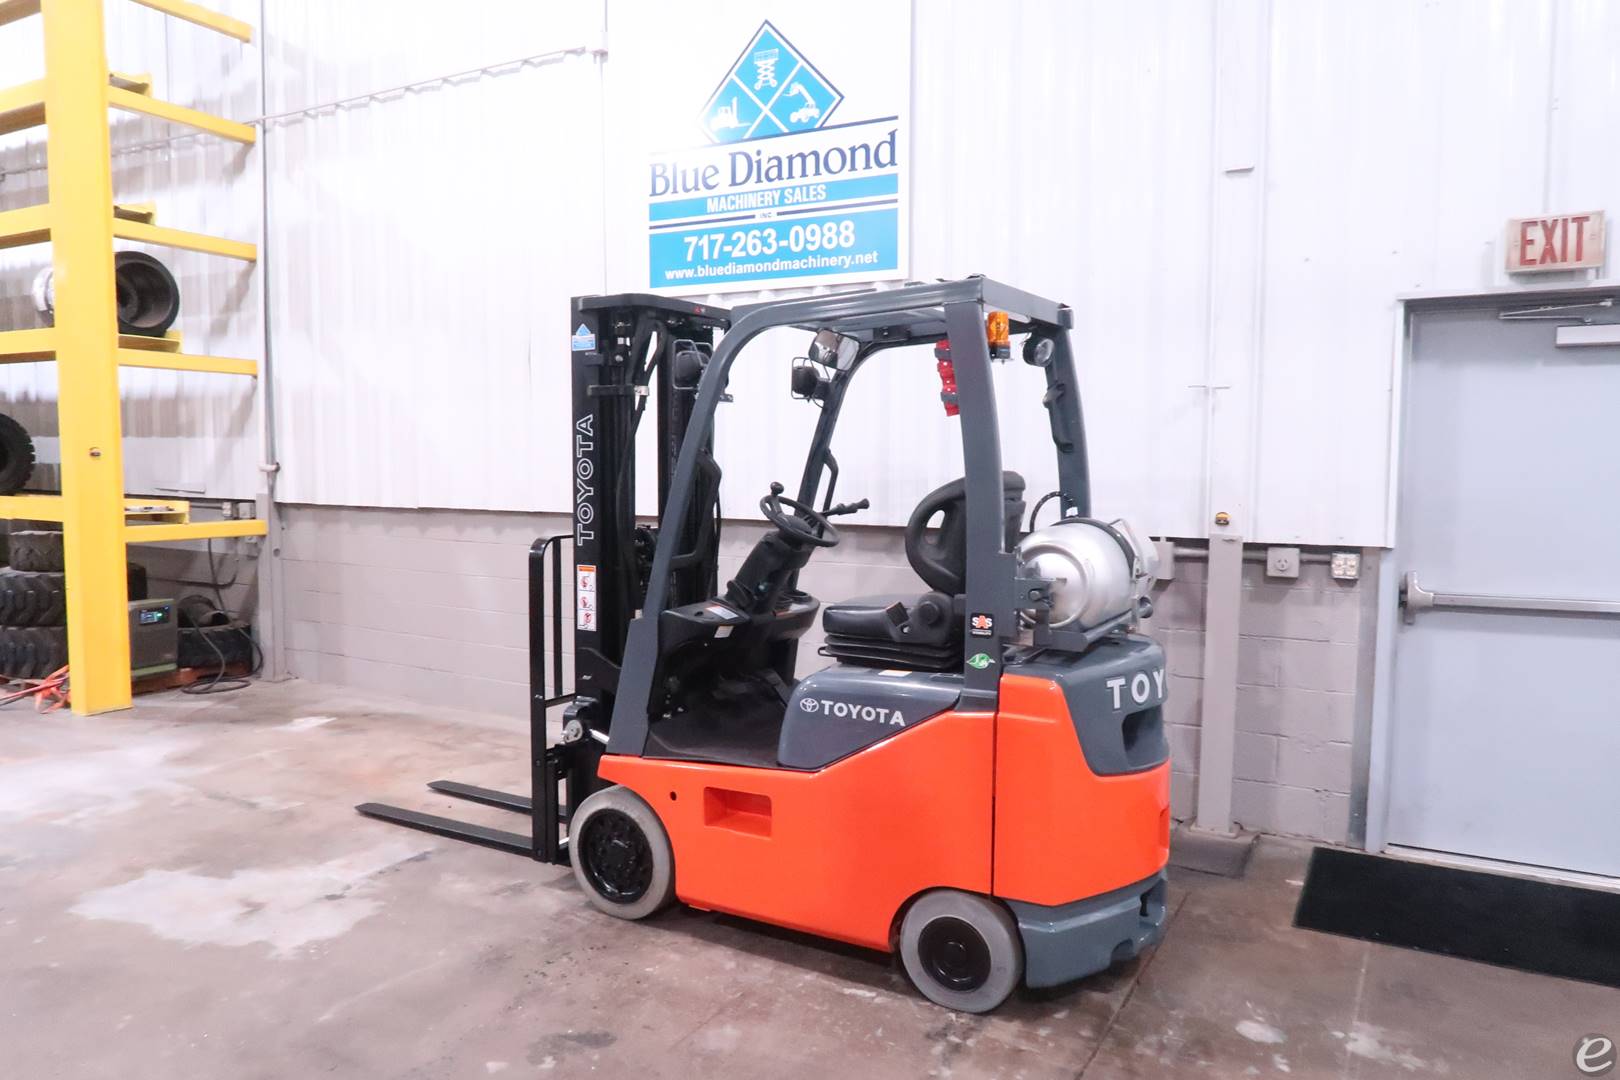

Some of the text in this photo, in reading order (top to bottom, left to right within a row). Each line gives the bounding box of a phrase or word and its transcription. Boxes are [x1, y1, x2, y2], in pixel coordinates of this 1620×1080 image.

[649, 128, 898, 197] Blue Diamond
[706, 184, 827, 213] MACHINERY SALES
[684, 220, 856, 262] 717-263-0988
[1519, 215, 1590, 267] EXIT
[664, 251, 879, 281] www.bluediamondmachinery.net
[576, 414, 594, 546] TOYOTA
[1106, 669, 1164, 709] TOY
[820, 699, 906, 727] TOYOTA
